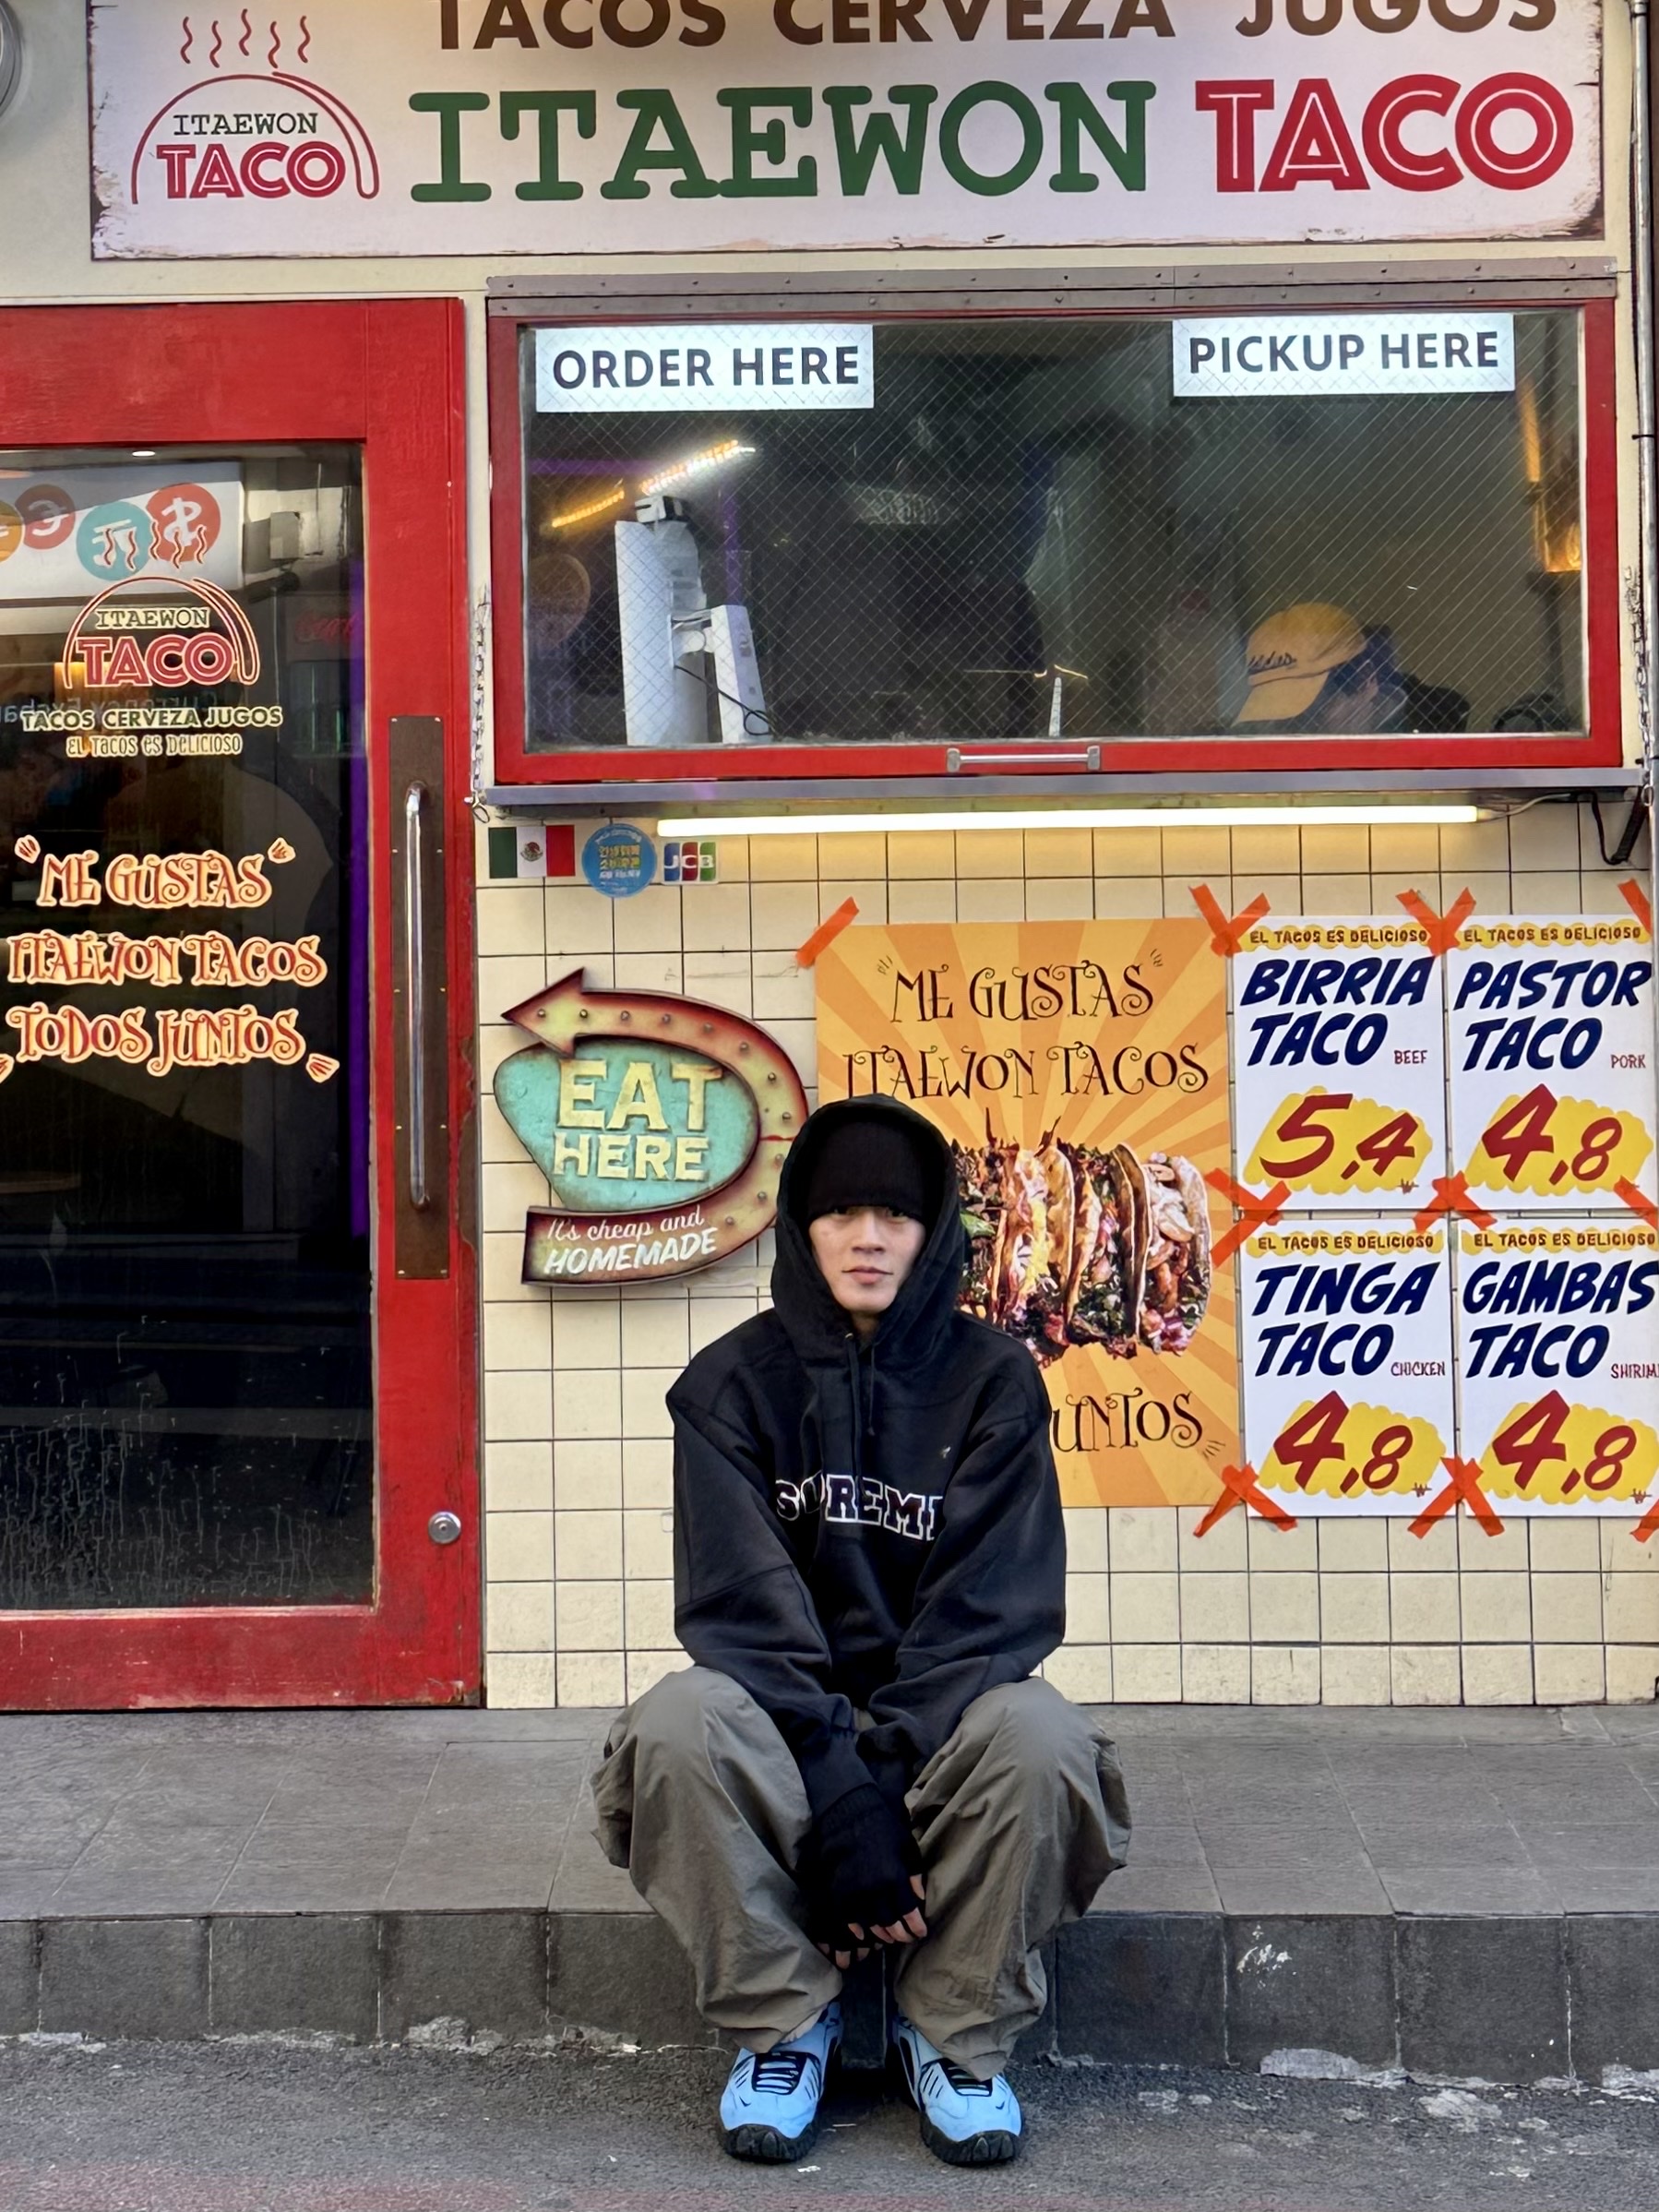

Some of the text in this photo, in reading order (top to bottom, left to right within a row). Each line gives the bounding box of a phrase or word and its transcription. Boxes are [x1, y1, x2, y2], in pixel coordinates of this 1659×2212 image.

[440, 0, 726, 50] TACOS
[773, 0, 1176, 46] CERVEZA
[173, 113, 318, 136] ITAEWON
[409, 72, 1574, 202] ITAEWON TACO
[156, 140, 346, 198] TACO
[553, 345, 860, 389] ORDER HERE
[1188, 331, 1499, 374] PICKUP HERE
[96, 607, 209, 628] ITAEWON
[77, 633, 235, 687] TACO
[22, 706, 282, 731] TACOS CERVEZA JUGOS
[37, 850, 271, 908] ME GUSTAS
[7, 929, 328, 986] ITAEWON TACOS
[1249, 929, 1428, 943] EL TACOS ES DELICIOSO
[1463, 927, 1641, 942] EL TACOS ES DELICIOSO
[890, 960, 1154, 1022] ME GUSTAS
[1240, 956, 1435, 1007] BIRRIA
[1453, 959, 1653, 1011] PASTOR
[6, 1002, 305, 1077] TODOS JUNTOS
[1247, 1011, 1428, 1067] TACO BEEF
[1462, 1016, 1646, 1071] TACO PORK
[557, 1058, 723, 1131] EAT
[841, 1041, 1210, 1100] ITAEWON TACOS
[553, 1131, 710, 1182] HERE
[587, 1218, 654, 1243] cheap
[660, 1203, 705, 1233] and
[1258, 1235, 1434, 1249] EL TACOS ES DELICIOSO
[1474, 1232, 1656, 1247] EL TACOS ES DELICIOSO
[543, 1226, 719, 1275] HOMEMADE
[1251, 1261, 1441, 1316] TINGA
[1462, 1259, 1659, 1315] GAMBAS
[1255, 1321, 1446, 1377] TACO CHICKEN
[1465, 1321, 1610, 1379] TACO
[1051, 1387, 1203, 1453] UNTOS
